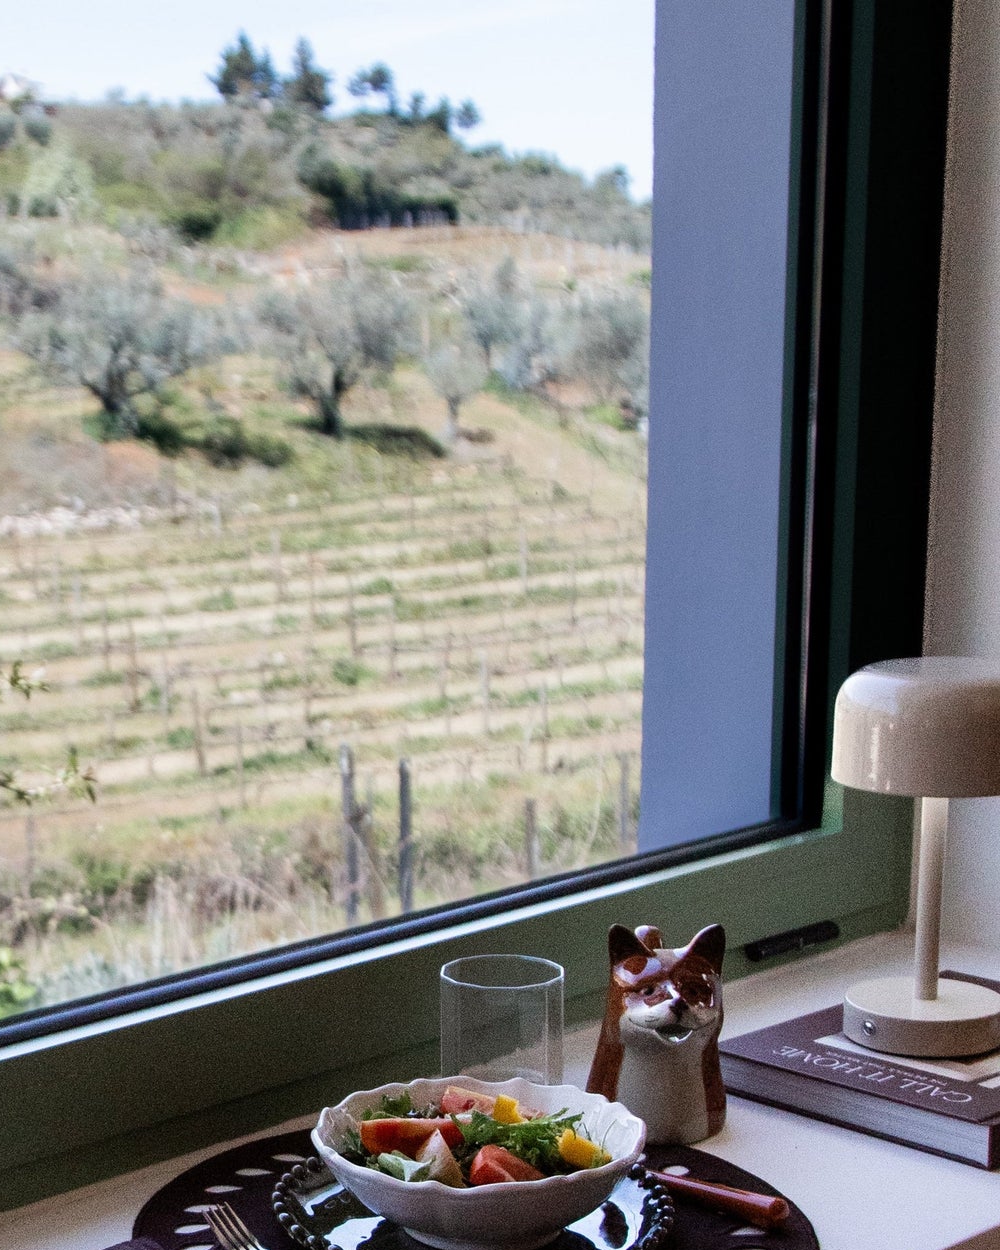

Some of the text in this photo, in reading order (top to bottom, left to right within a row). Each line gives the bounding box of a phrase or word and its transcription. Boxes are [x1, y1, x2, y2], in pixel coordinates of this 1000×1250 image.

[772, 1045, 863, 1074] HOME
[858, 1071, 896, 1083] IT
[900, 1078, 973, 1103] CALL
